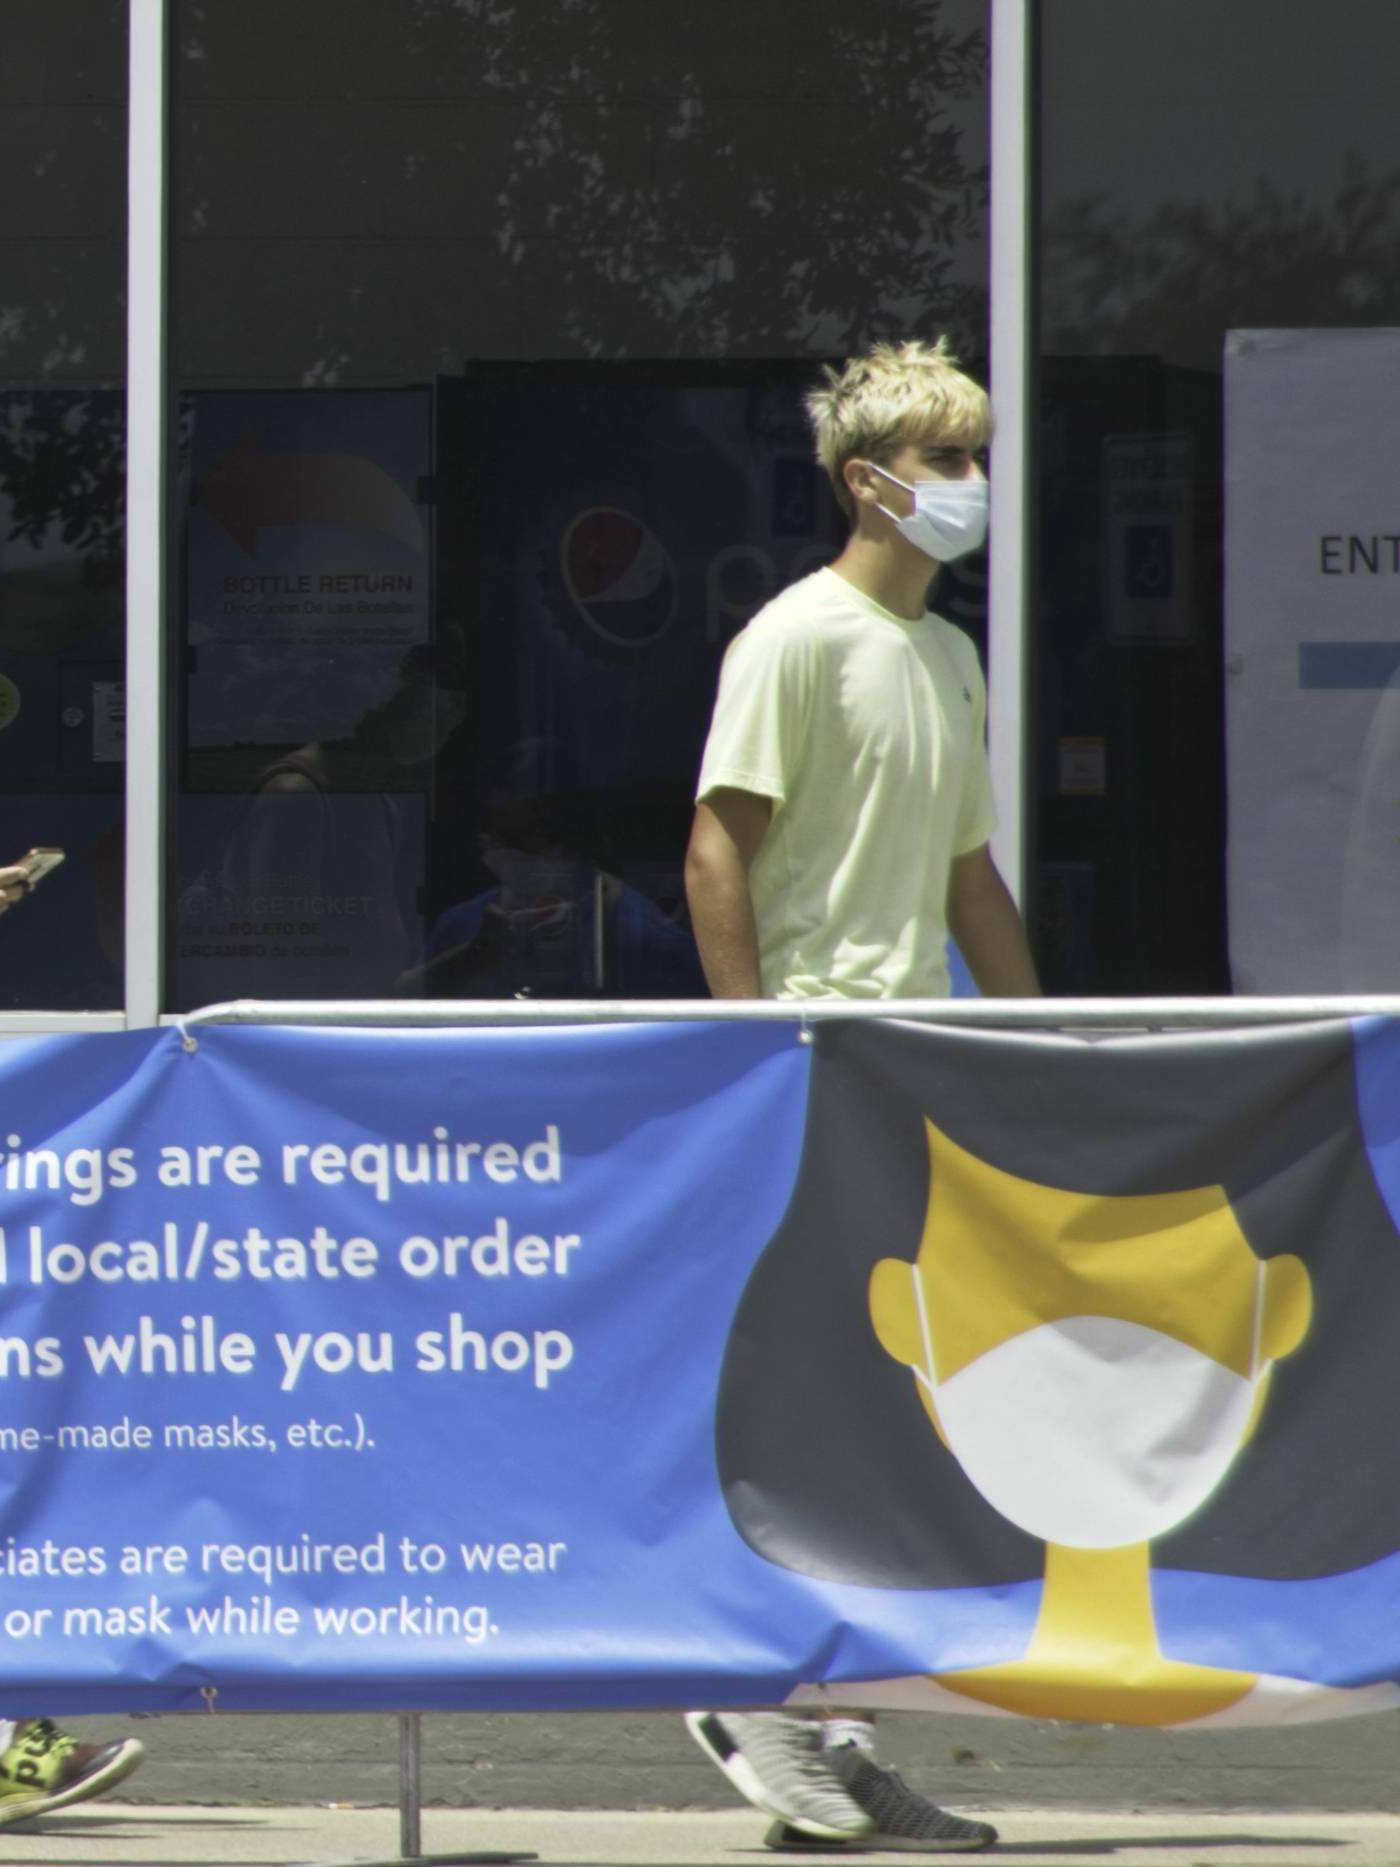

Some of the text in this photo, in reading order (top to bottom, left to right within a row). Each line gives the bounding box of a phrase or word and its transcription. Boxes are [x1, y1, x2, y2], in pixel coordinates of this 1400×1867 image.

[1320, 535, 1400, 575] ENT
[223, 574, 414, 594] BOTTLE RETURN
[289, 896, 374, 915] TICKET
[157, 1143, 261, 1187] are
[283, 1125, 563, 1202] required
[29, 1221, 378, 1284] local/state
[399, 1218, 581, 1278] order
[84, 1315, 256, 1375] while
[275, 1331, 393, 1391] you
[415, 1312, 574, 1389] shop
[164, 1414, 277, 1453] masks,
[286, 1412, 376, 1452] etc.).
[120, 1545, 188, 1575] are
[202, 1532, 385, 1585] required
[399, 1536, 446, 1574] to
[460, 1541, 567, 1573] wear
[4, 1608, 52, 1638] or
[63, 1594, 172, 1636] mask
[186, 1596, 300, 1636] while
[314, 1596, 500, 1645] working.
